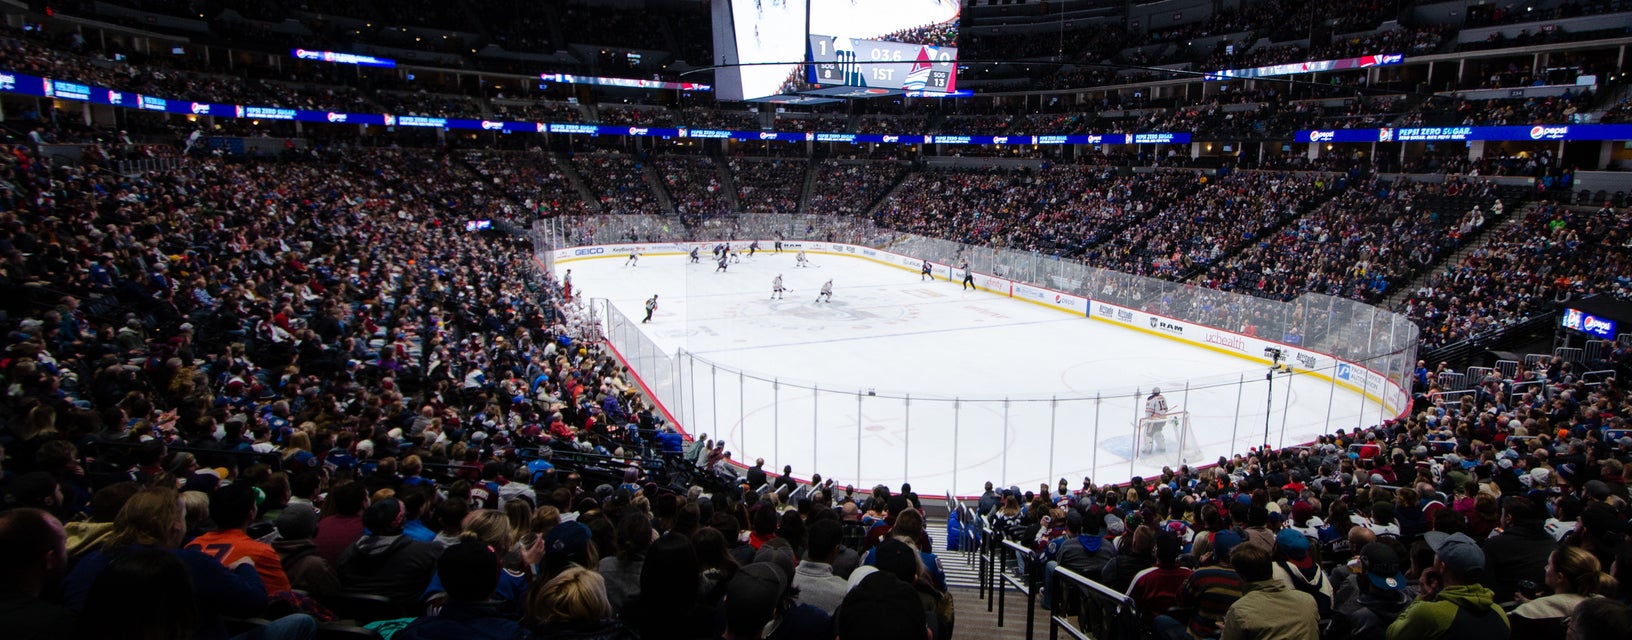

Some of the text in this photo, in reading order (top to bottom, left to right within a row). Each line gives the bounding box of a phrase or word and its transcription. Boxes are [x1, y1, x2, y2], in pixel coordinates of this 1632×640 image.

[819, 41, 826, 55] 1
[871, 49, 902, 61] 03.6
[824, 70, 831, 78] 8
[872, 68, 894, 81] 1ST
[934, 78, 945, 87] 13
[1399, 128, 1420, 136] PEPSI
[1543, 126, 1568, 135] pepsi
[575, 243, 604, 256] GEICO
[1160, 321, 1183, 332] RAM
[1593, 320, 1610, 331] pepsi
[1206, 331, 1245, 351] uchealth
